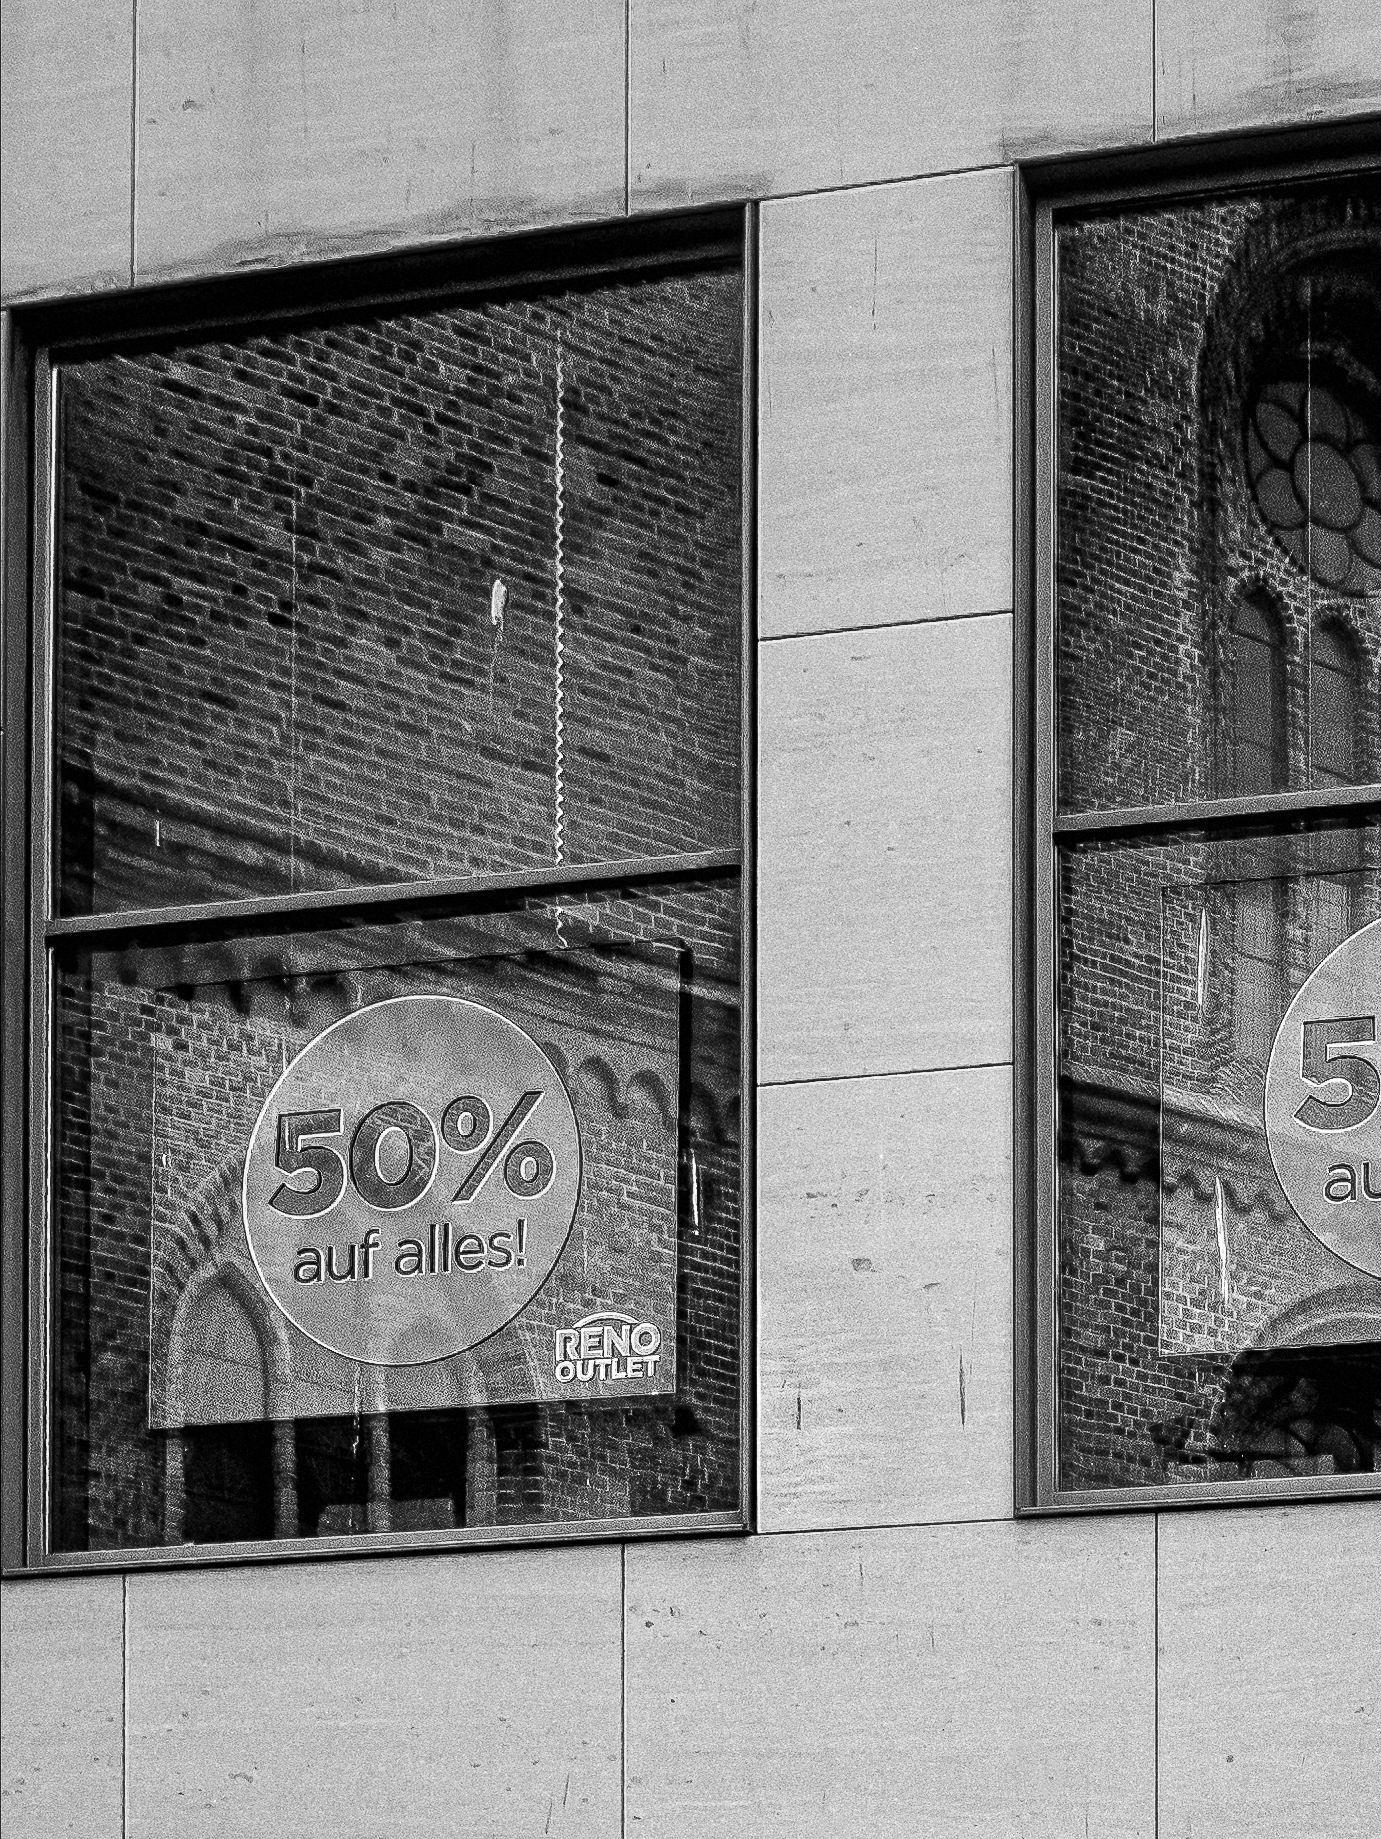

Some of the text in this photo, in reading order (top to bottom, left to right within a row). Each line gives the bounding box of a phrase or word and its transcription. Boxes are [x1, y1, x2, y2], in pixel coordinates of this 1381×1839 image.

[267, 1089, 557, 1220] 50%
[293, 1220, 528, 1285] auf alles!
[555, 1321, 661, 1362] RENO
[555, 1355, 660, 1384] OUTLET
